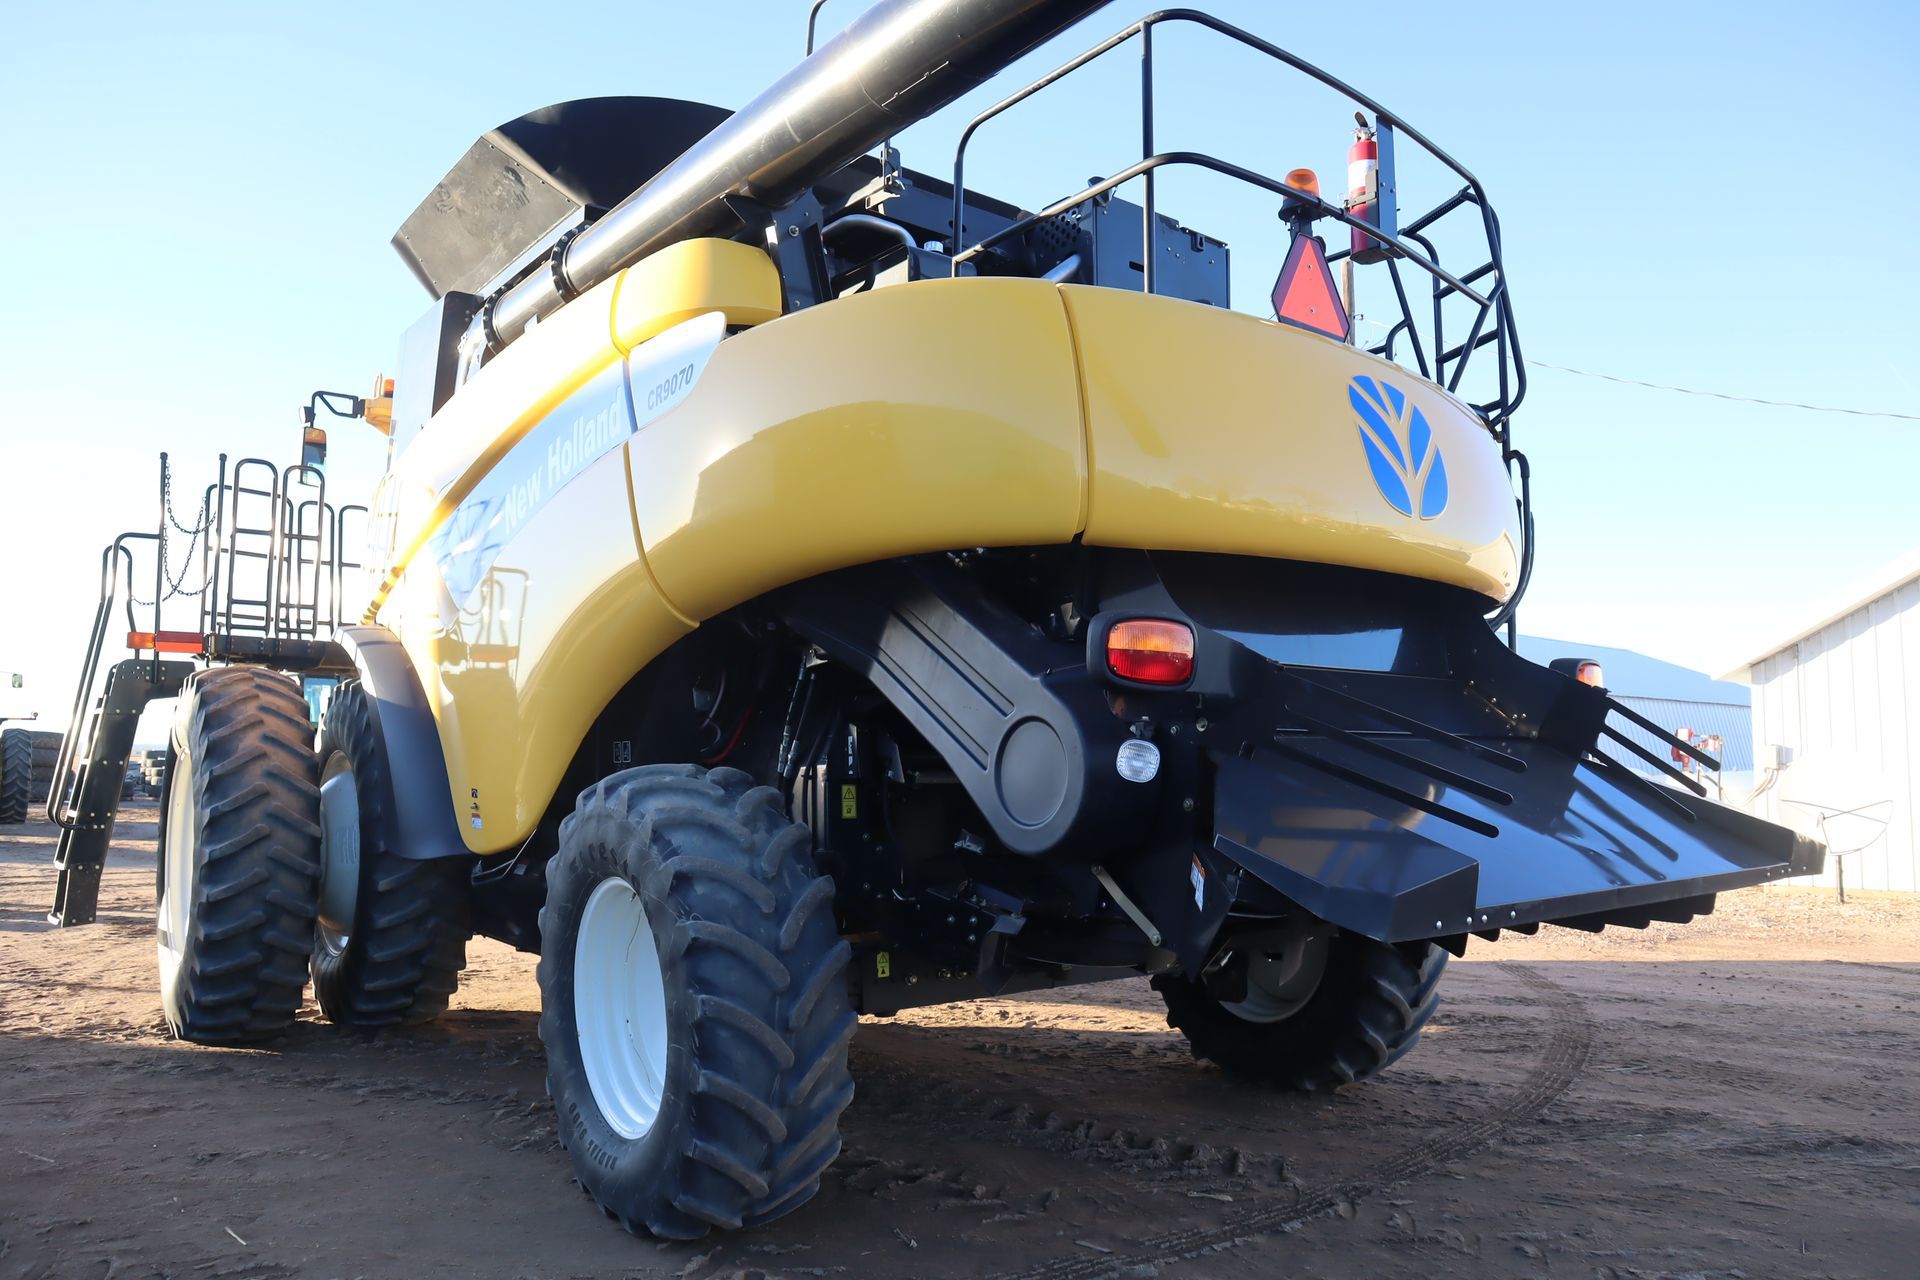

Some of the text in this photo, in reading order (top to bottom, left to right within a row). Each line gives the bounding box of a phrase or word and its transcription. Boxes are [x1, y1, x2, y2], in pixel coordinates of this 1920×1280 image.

[647, 363, 694, 411] CR9070
[503, 384, 622, 536] New Holland
